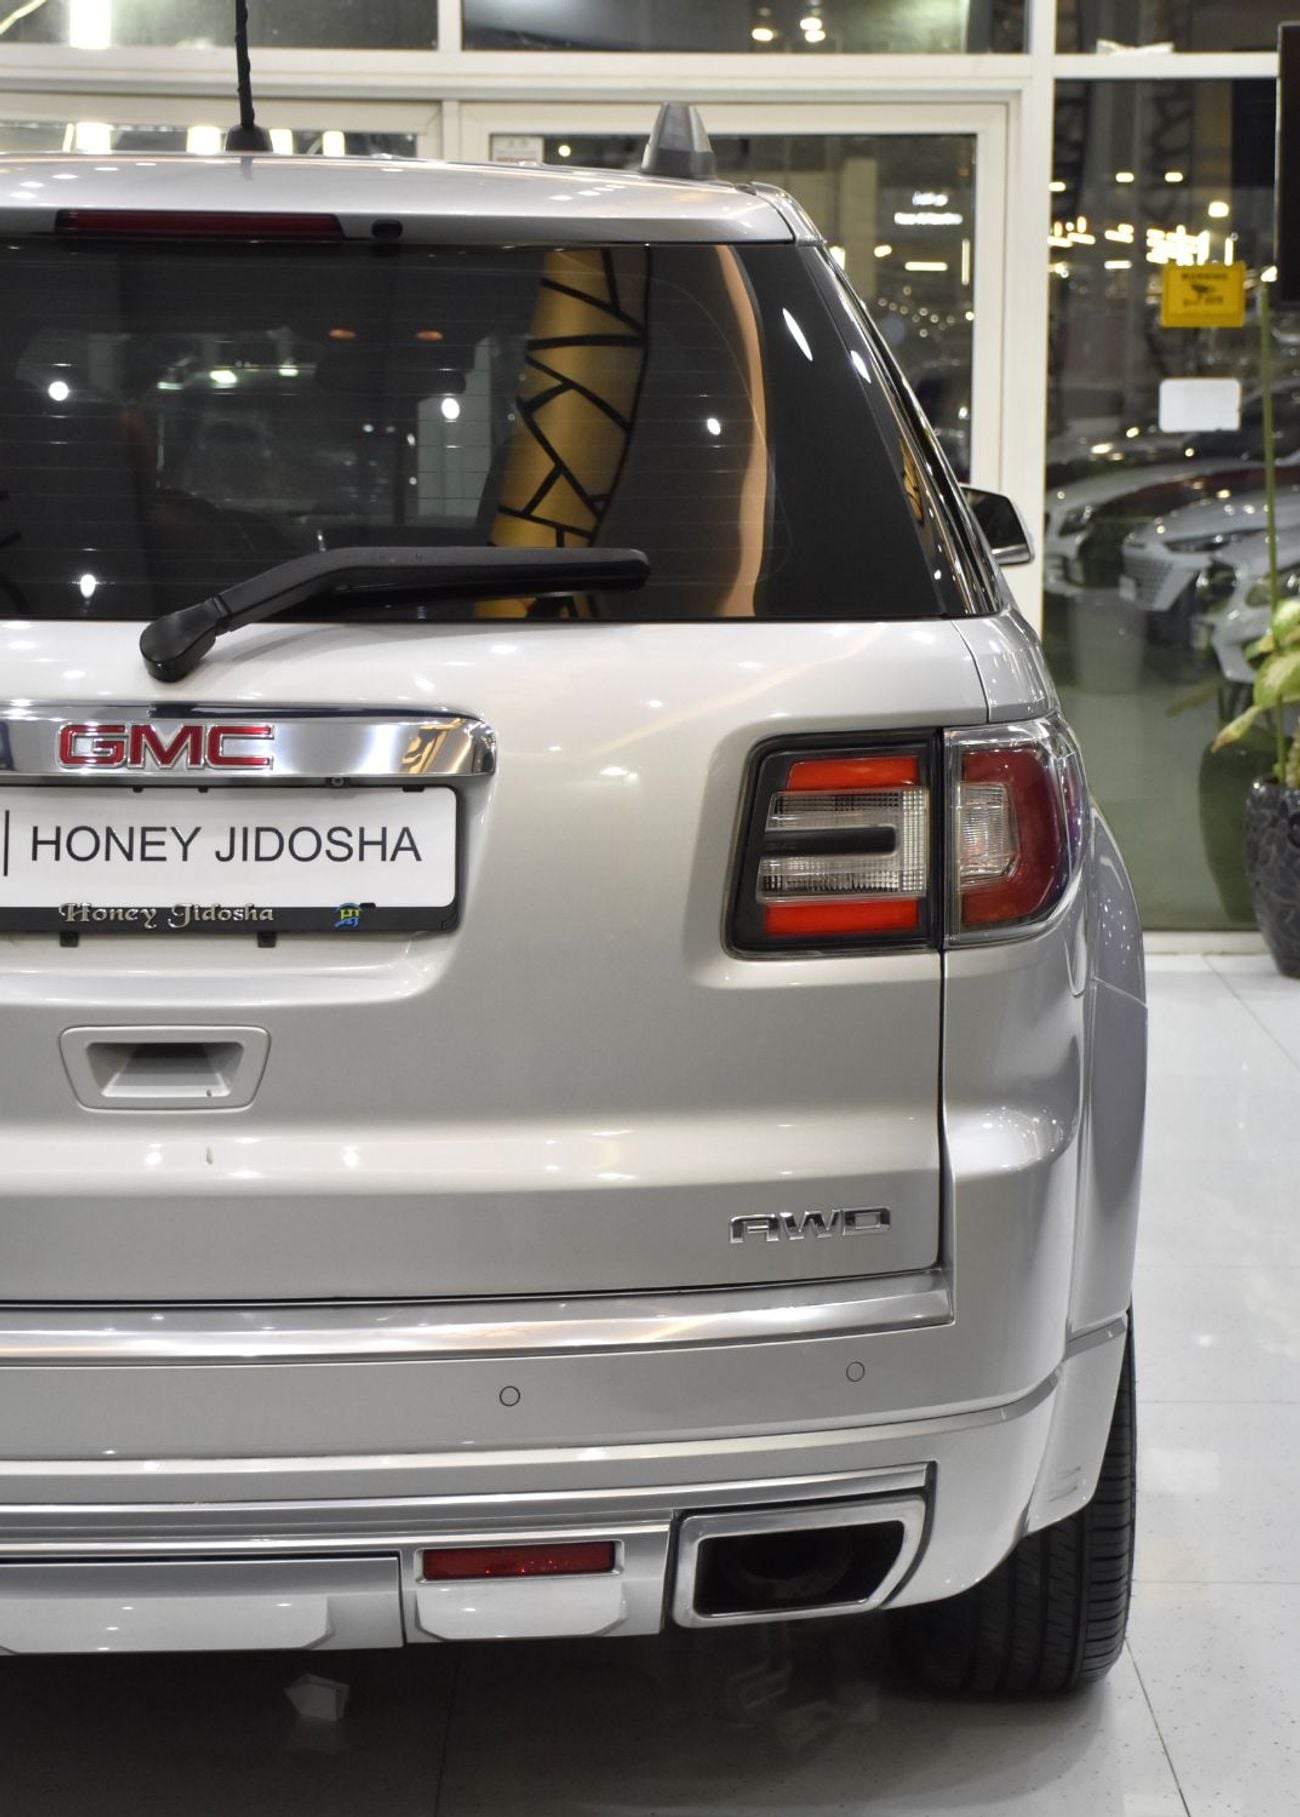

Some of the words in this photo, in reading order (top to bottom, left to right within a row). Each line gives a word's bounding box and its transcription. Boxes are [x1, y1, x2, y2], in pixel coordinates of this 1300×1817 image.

[59, 723, 274, 770] GMC
[31, 825, 202, 862] HONEY
[215, 825, 422, 863] JIDOSHA
[58, 902, 158, 929] Honey
[168, 902, 274, 929] Jidosha
[730, 1206, 892, 1244] AWD
